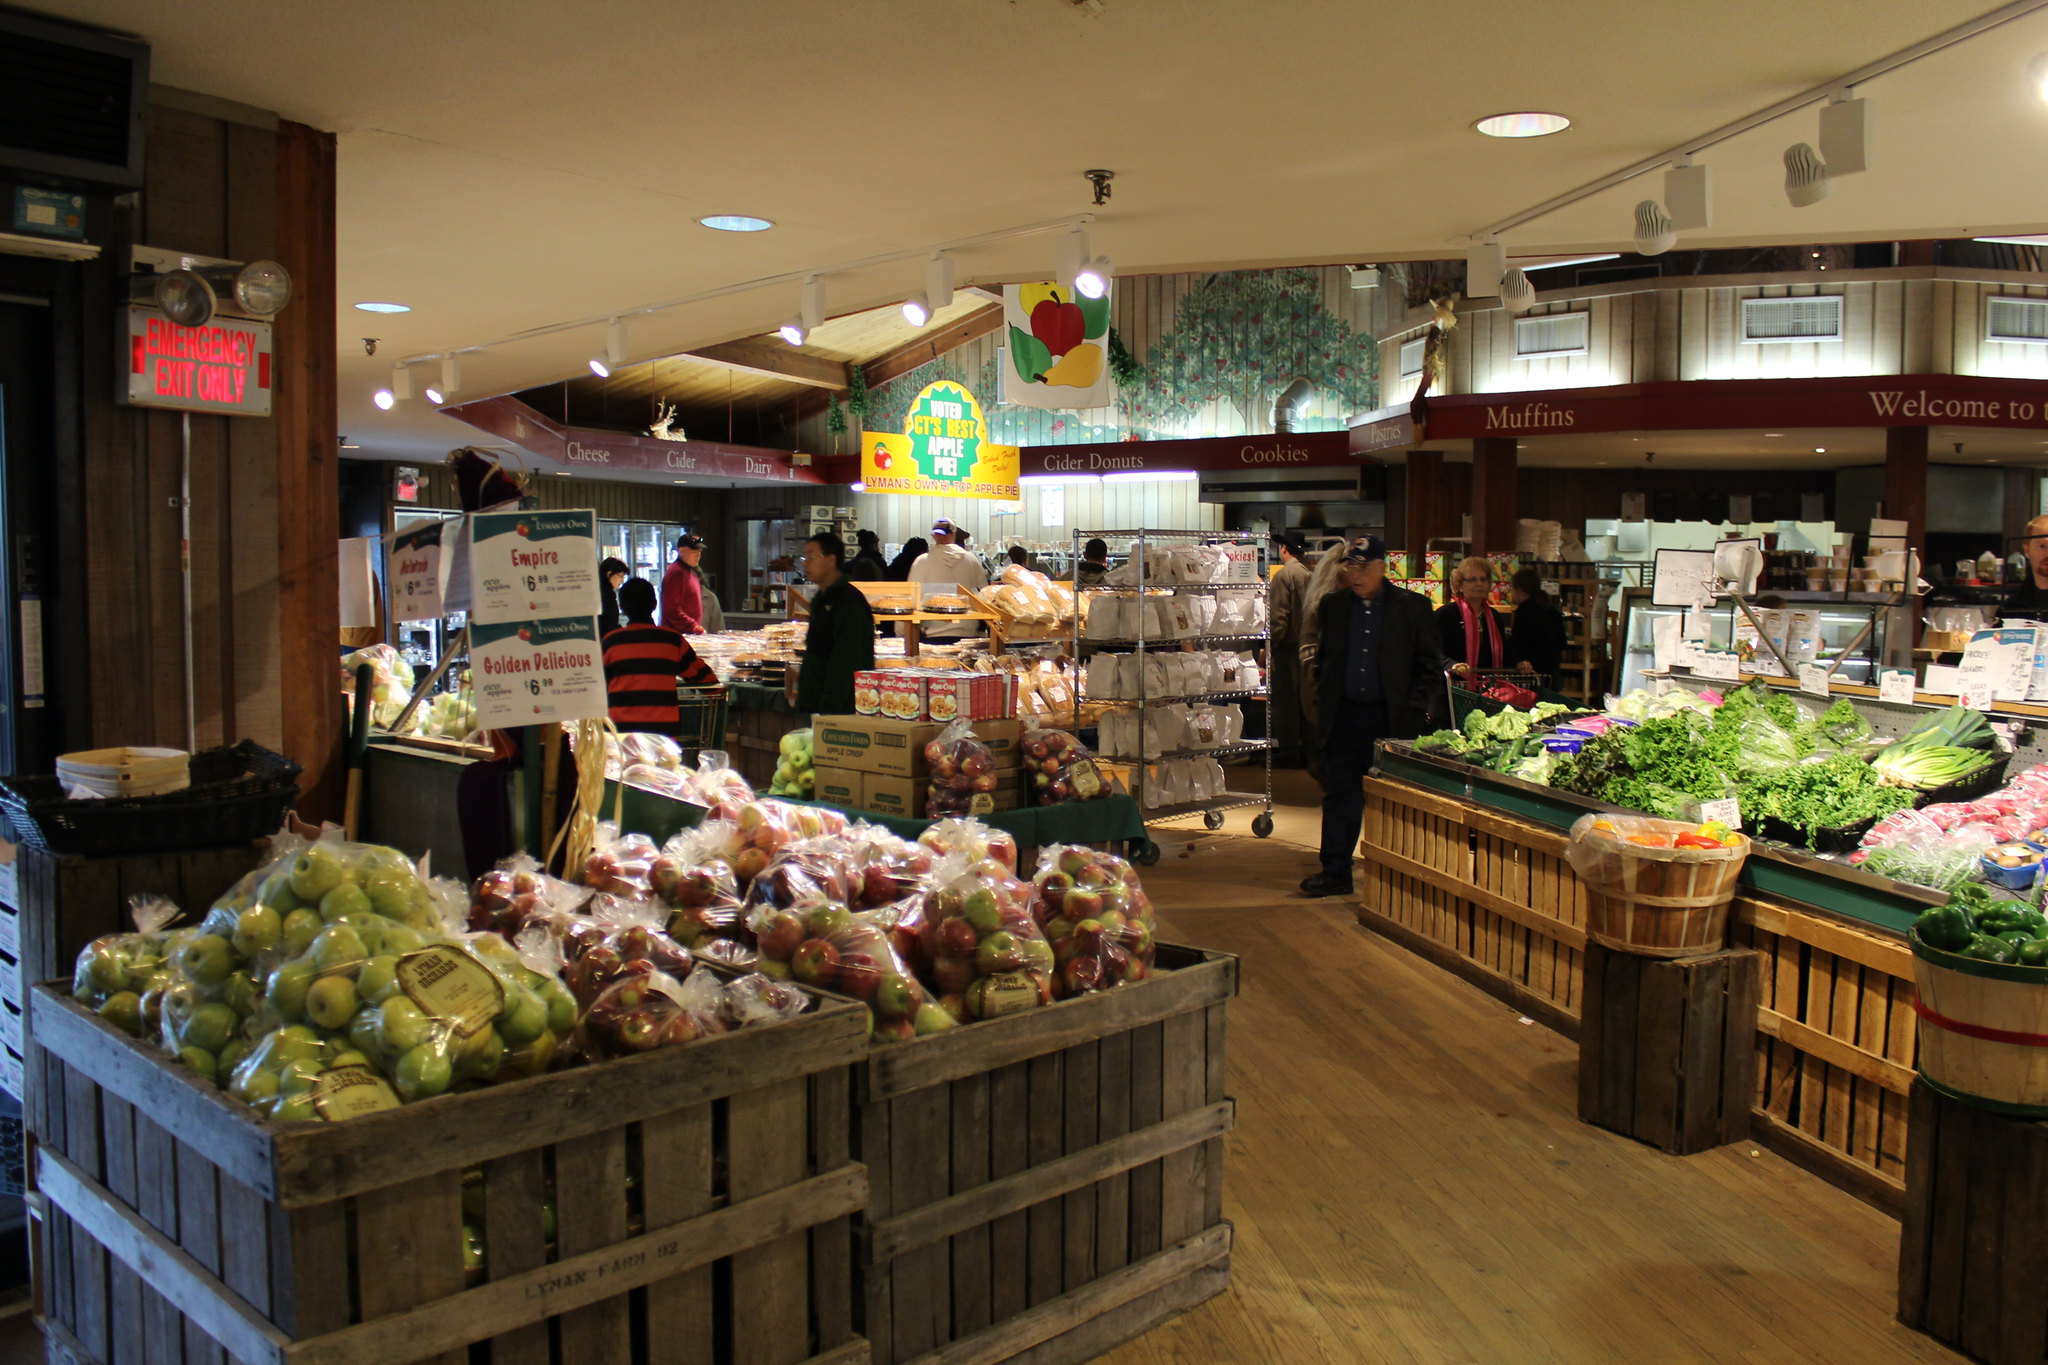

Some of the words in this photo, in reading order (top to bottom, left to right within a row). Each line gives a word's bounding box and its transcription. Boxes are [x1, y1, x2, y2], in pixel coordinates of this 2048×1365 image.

[147, 318, 256, 367] EMERGENCY
[156, 358, 196, 398] EXIT
[198, 364, 246, 403] ONLY
[930, 400, 963, 419] VOTED
[1869, 390, 1999, 419] Welcome
[2008, 400, 2033, 420] to
[1485, 403, 1575, 429] Muffins
[914, 415, 943, 436] CT'S
[947, 418, 975, 439] BEST
[1371, 424, 1402, 444] Pastries
[567, 441, 611, 464] Cheese
[928, 436, 964, 457] APPLE
[1241, 445, 1309, 465] Cookies
[667, 450, 697, 470] Cider
[745, 457, 773, 478] Dairy
[1044, 455, 1085, 471] Cider
[1089, 453, 1144, 470] Donuts
[866, 476, 910, 489] LYMAN'S
[914, 479, 938, 491] OWN
[974, 483, 1003, 495] APPLE
[1005, 485, 1018, 497] PIE
[511, 548, 559, 570] Empire
[1225, 550, 1255, 563] okies!
[484, 656, 531, 675] Golden
[533, 651, 592, 672] Delicious
[827, 747, 845, 757] APPLE
[412, 954, 443, 977] LYMAN
[418, 960, 459, 989] ORCHARDS
